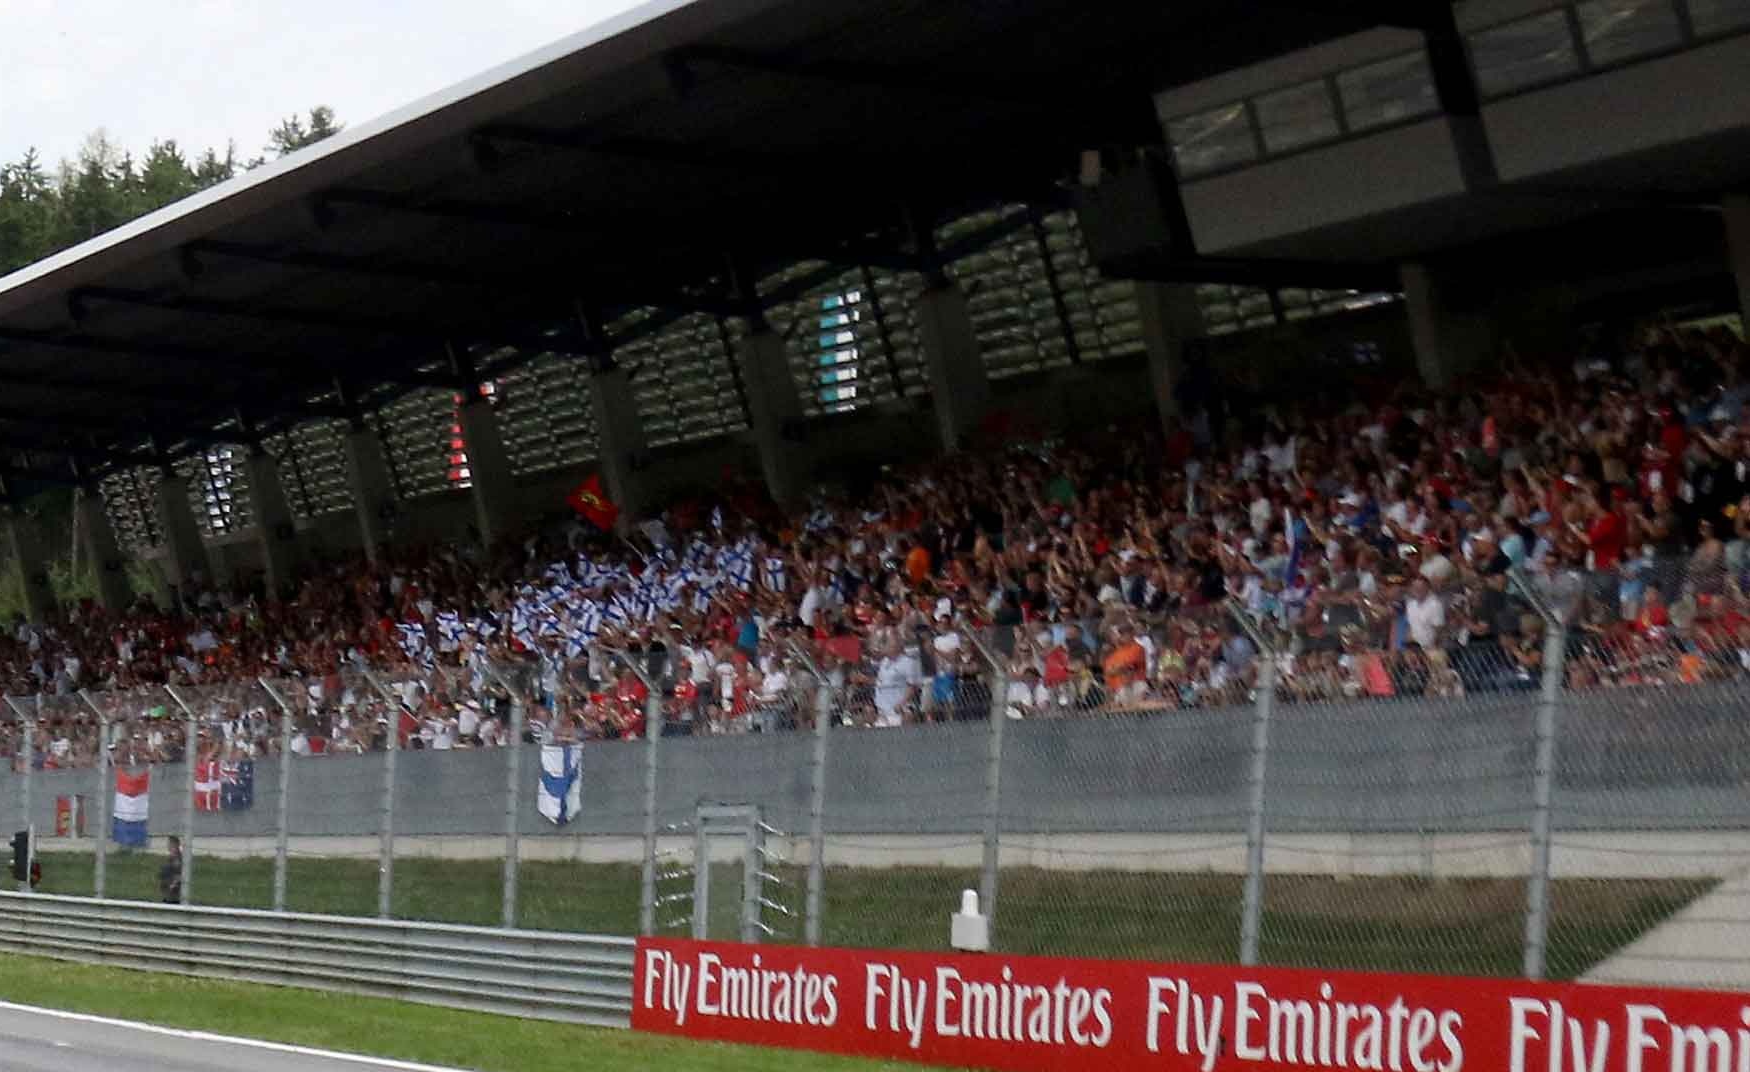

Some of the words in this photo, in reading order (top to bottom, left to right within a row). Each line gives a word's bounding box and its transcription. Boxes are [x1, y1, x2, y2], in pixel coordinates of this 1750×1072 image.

[644, 948, 691, 1026] Fly
[696, 952, 838, 1027] Emirates
[865, 962, 927, 1049] Fly
[935, 965, 1112, 1047] Emirates
